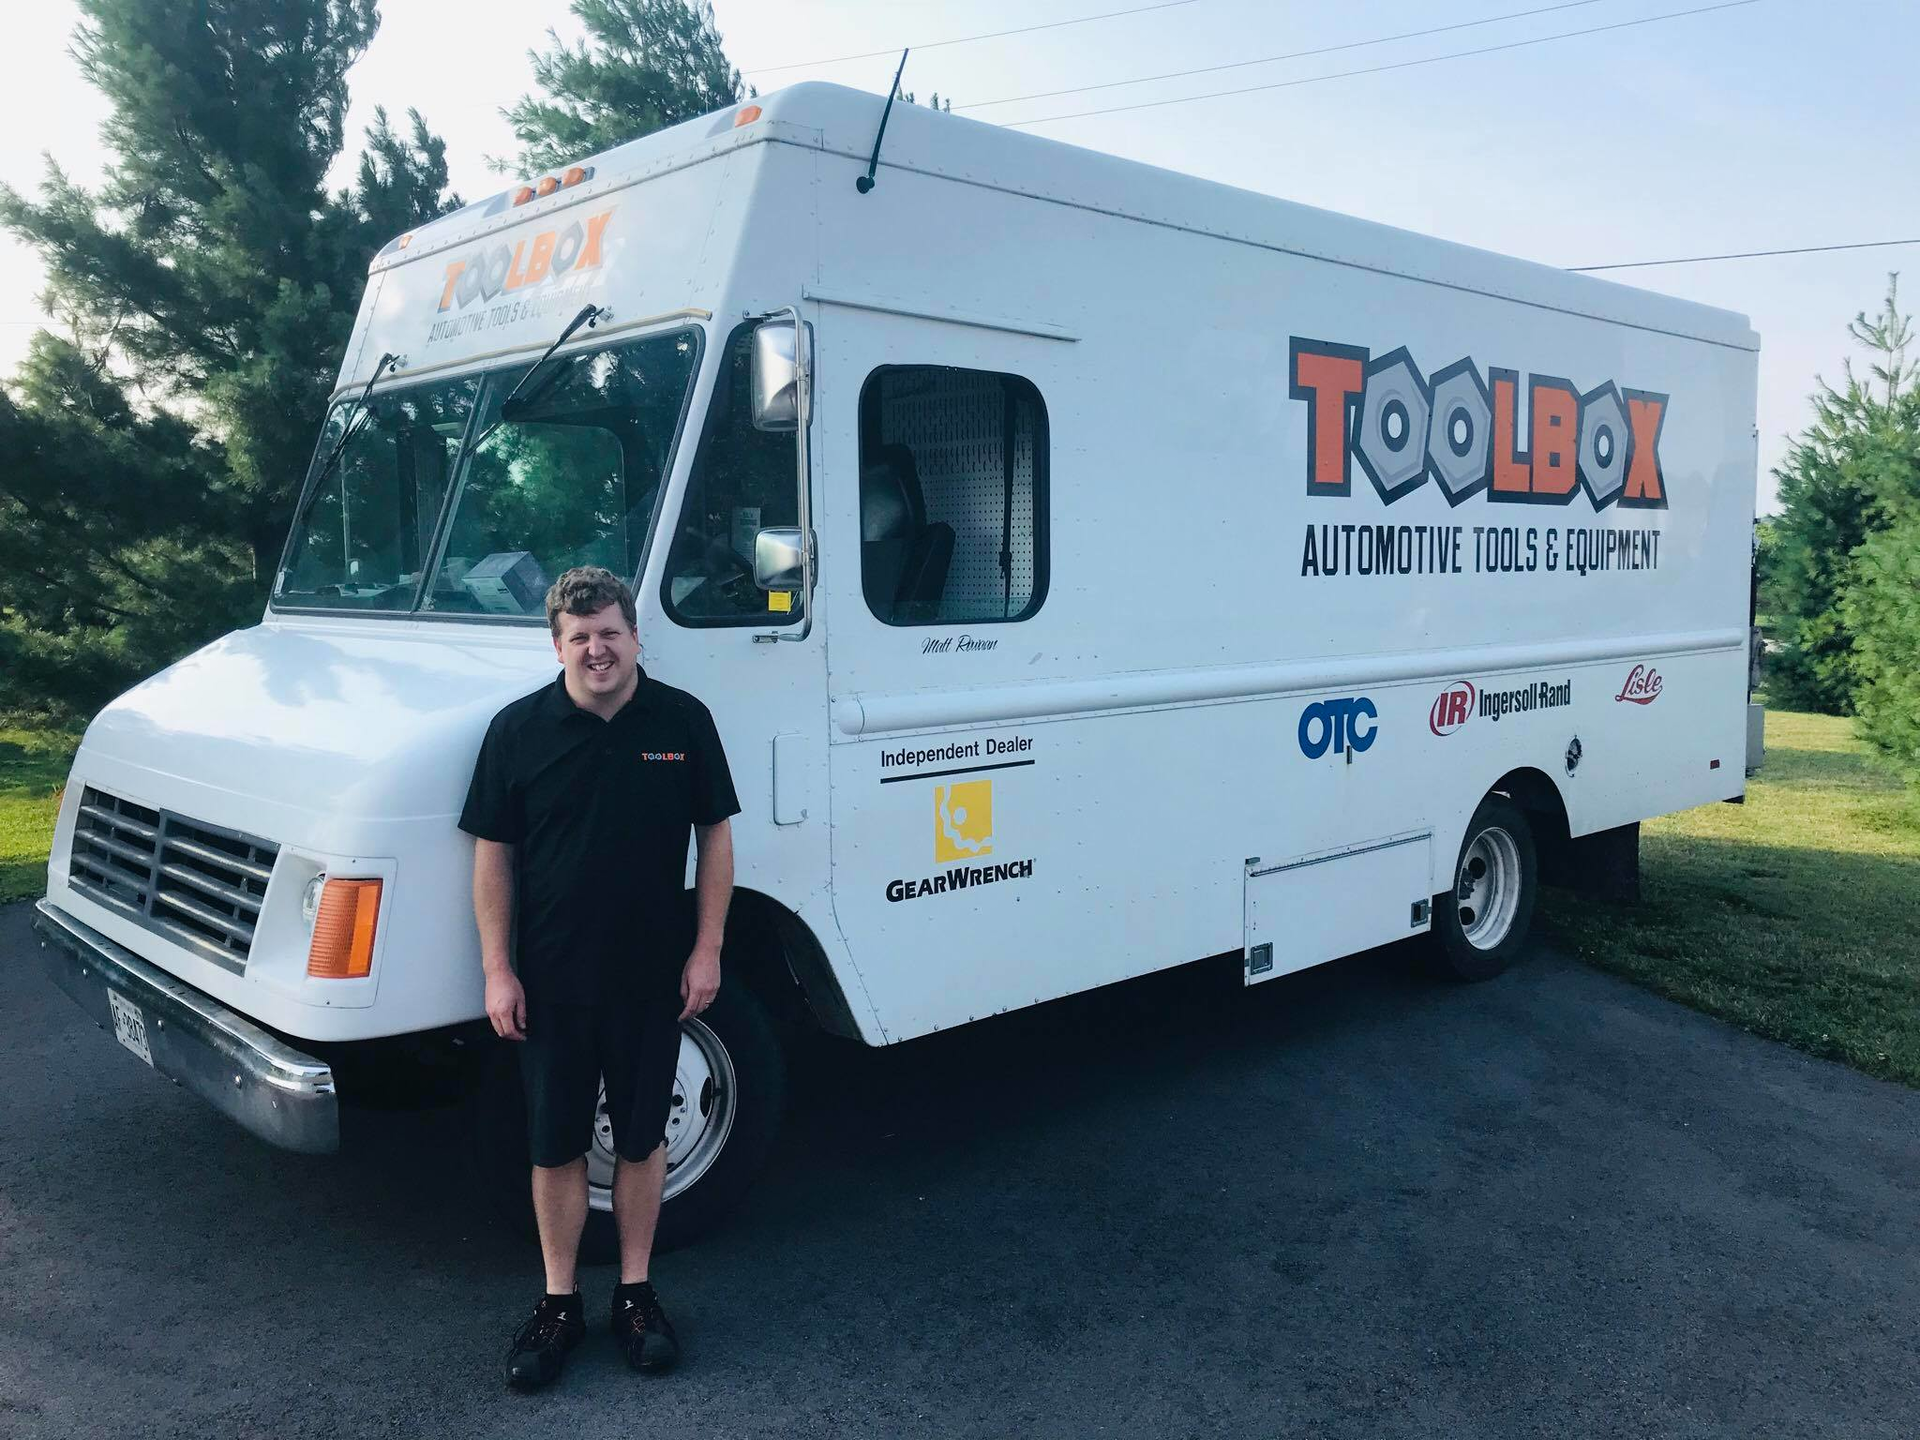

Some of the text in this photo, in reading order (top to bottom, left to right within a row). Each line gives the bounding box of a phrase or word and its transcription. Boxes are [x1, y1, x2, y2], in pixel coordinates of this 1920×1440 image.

[437, 208, 613, 314] TOOLBOX
[1289, 335, 1669, 513] TOOLBOX
[1301, 524, 1661, 577] AUTOMOTIVE TOOLS & EQUIPMENT
[1436, 690, 1469, 727] IR
[1614, 664, 1664, 706] Lisle
[881, 736, 1034, 768] Independent Dealer
[1298, 697, 1378, 760] OTC
